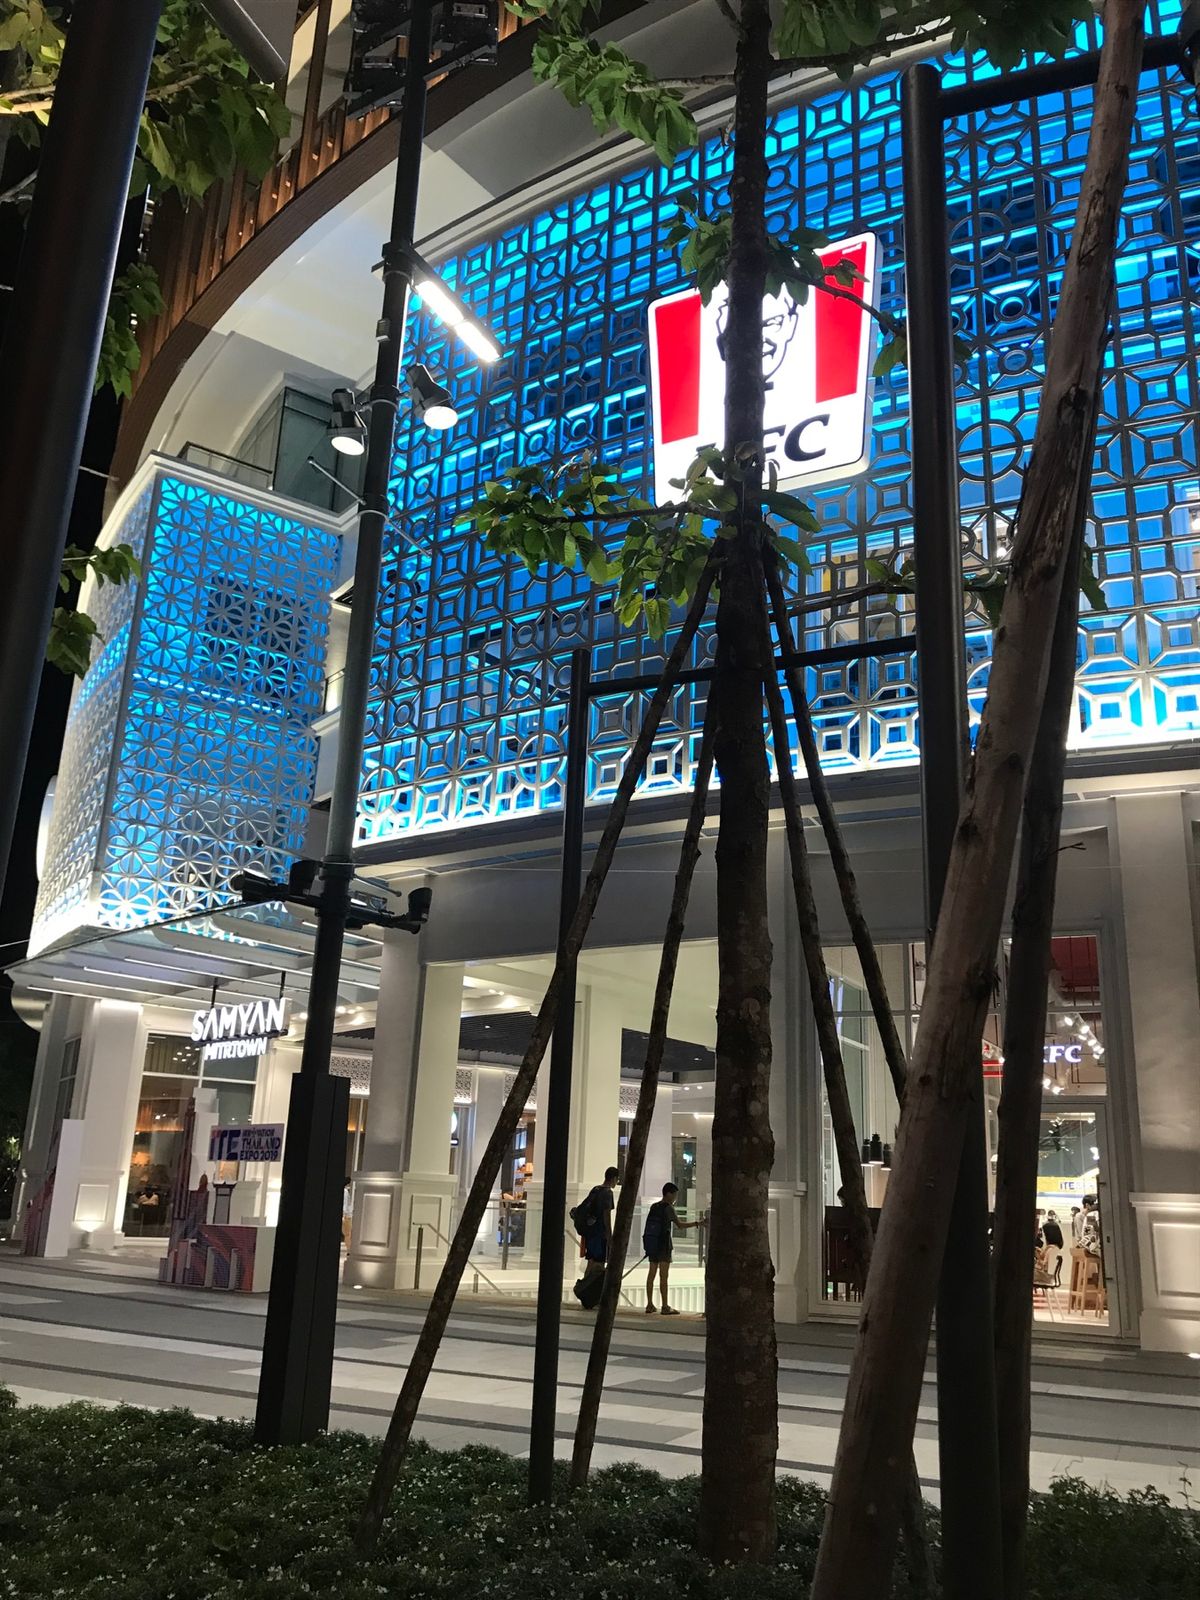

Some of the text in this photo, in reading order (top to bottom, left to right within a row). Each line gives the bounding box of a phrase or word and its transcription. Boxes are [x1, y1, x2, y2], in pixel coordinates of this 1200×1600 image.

[191, 998, 286, 1041] SAMYAN
[203, 1037, 267, 1060] MITRTOWN
[242, 1137, 281, 1150] THAILAND
[240, 1150, 278, 1161] EXPO 2019
